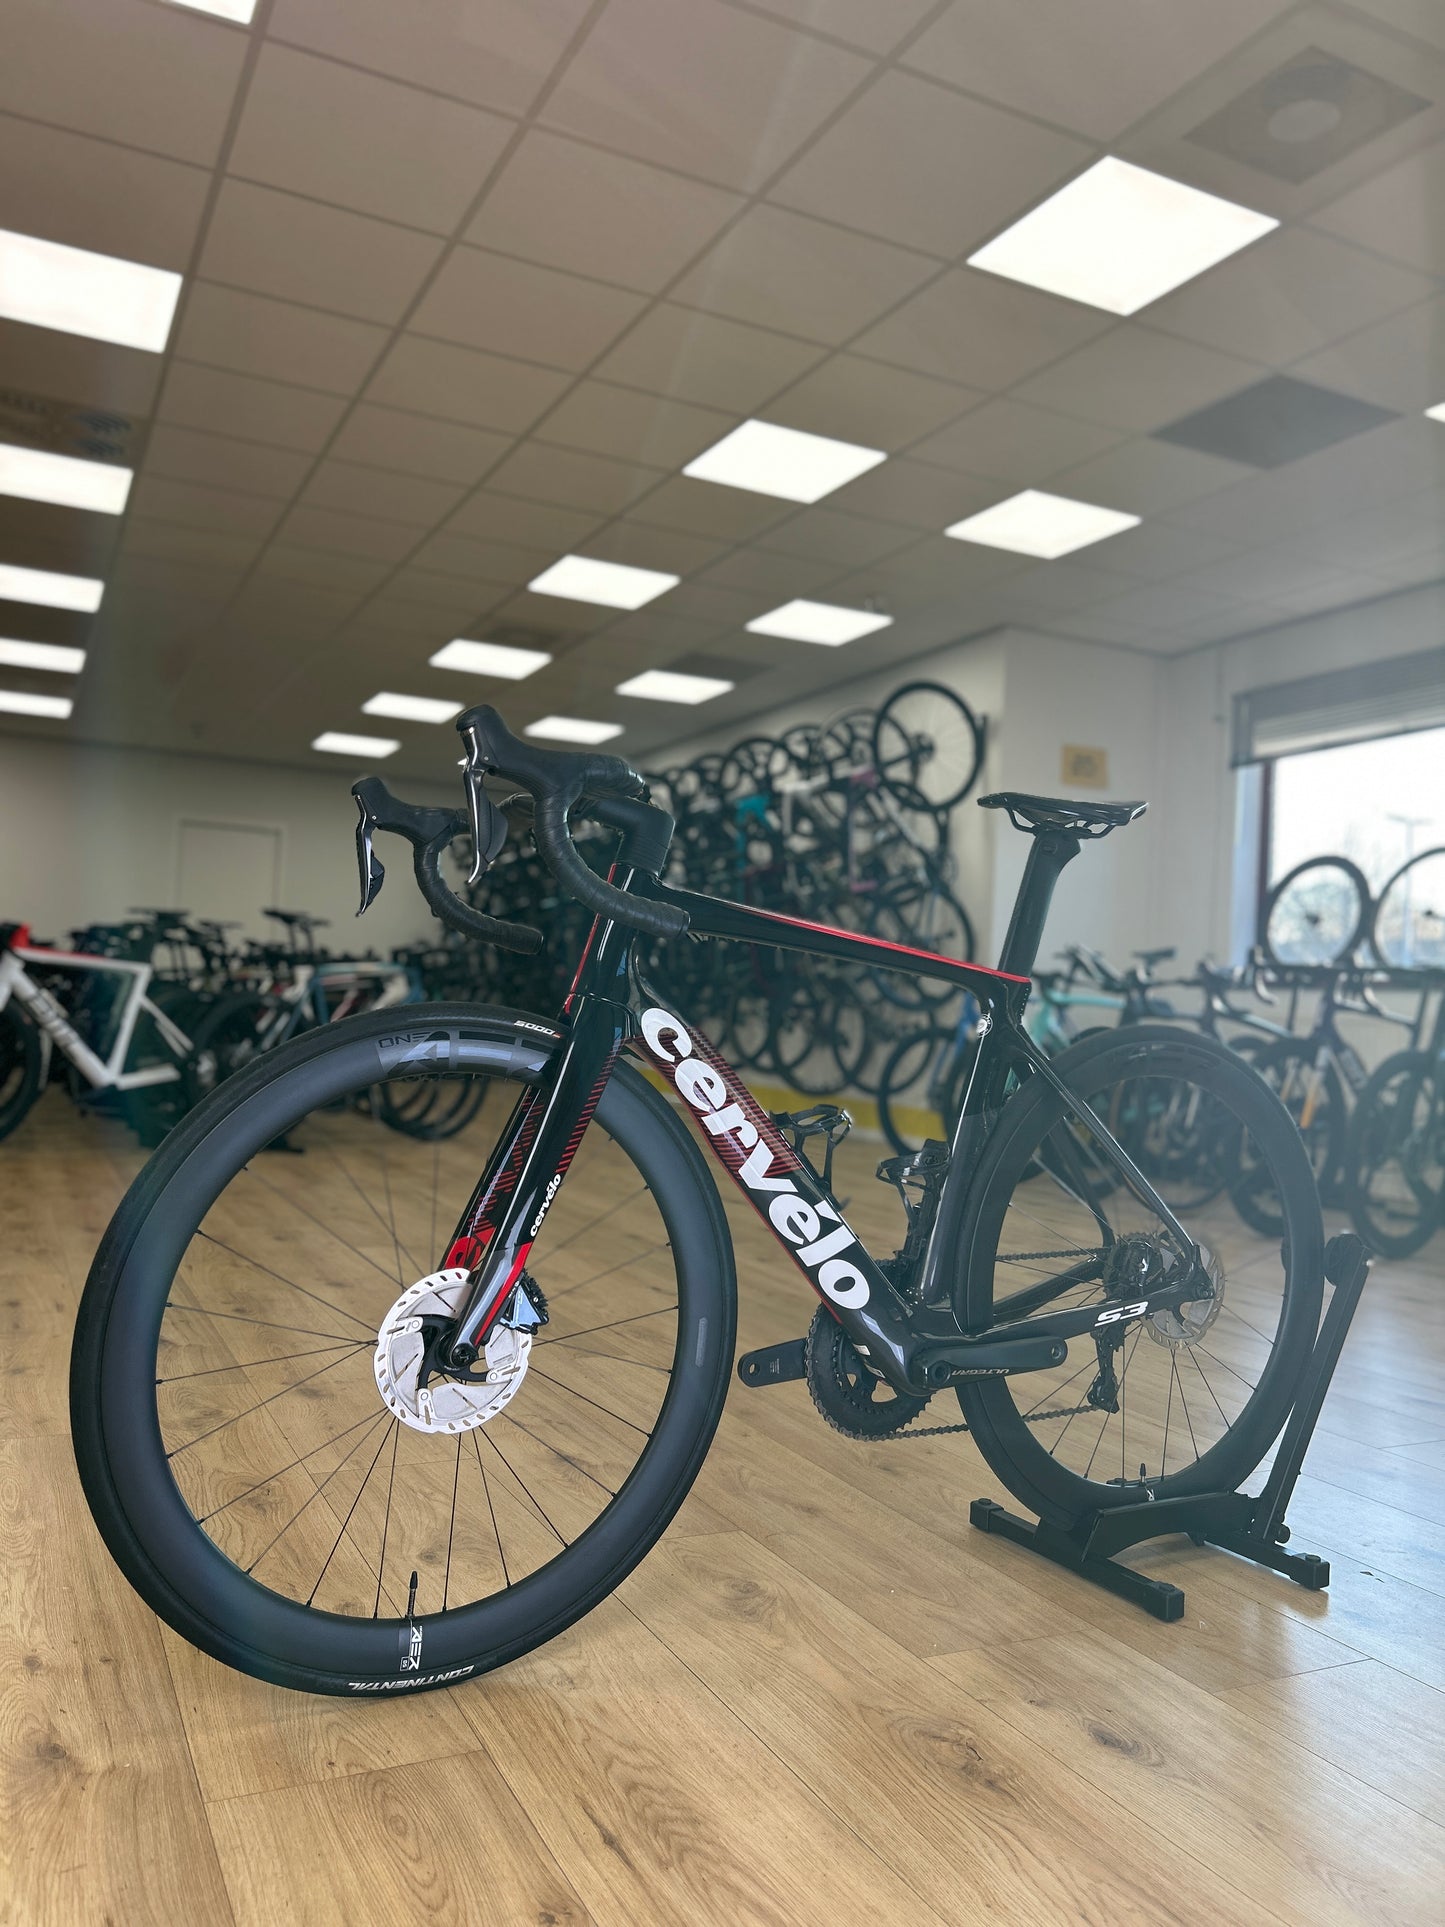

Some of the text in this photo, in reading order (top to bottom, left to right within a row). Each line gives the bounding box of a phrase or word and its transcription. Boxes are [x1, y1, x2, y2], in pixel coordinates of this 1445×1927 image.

[641, 1007, 871, 1310] cervélo
[530, 1173, 562, 1237] cervélo
[1094, 1301, 1149, 1327] S3
[348, 1664, 475, 1691] CONTINENTAL
